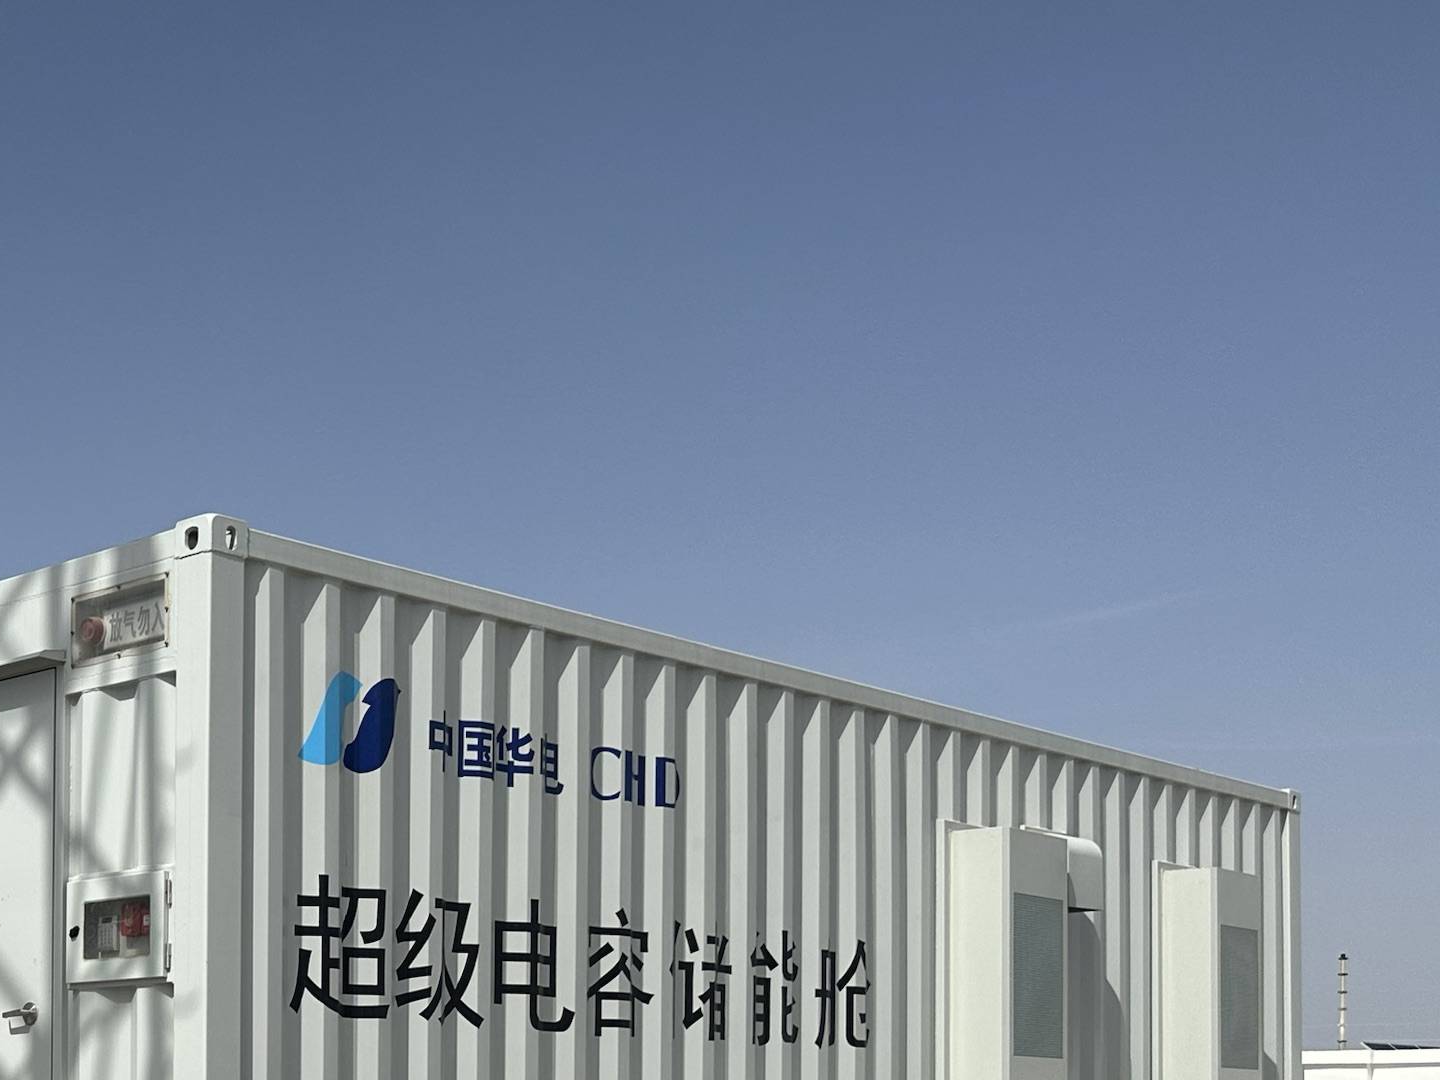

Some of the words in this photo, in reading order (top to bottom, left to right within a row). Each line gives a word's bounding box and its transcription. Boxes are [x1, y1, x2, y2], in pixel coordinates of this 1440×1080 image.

[109, 601, 165, 642] 放气勿入
[428, 710, 564, 796] 中国华电
[590, 745, 680, 808] CHD
[289, 874, 871, 1050] 超级电容储能舱
